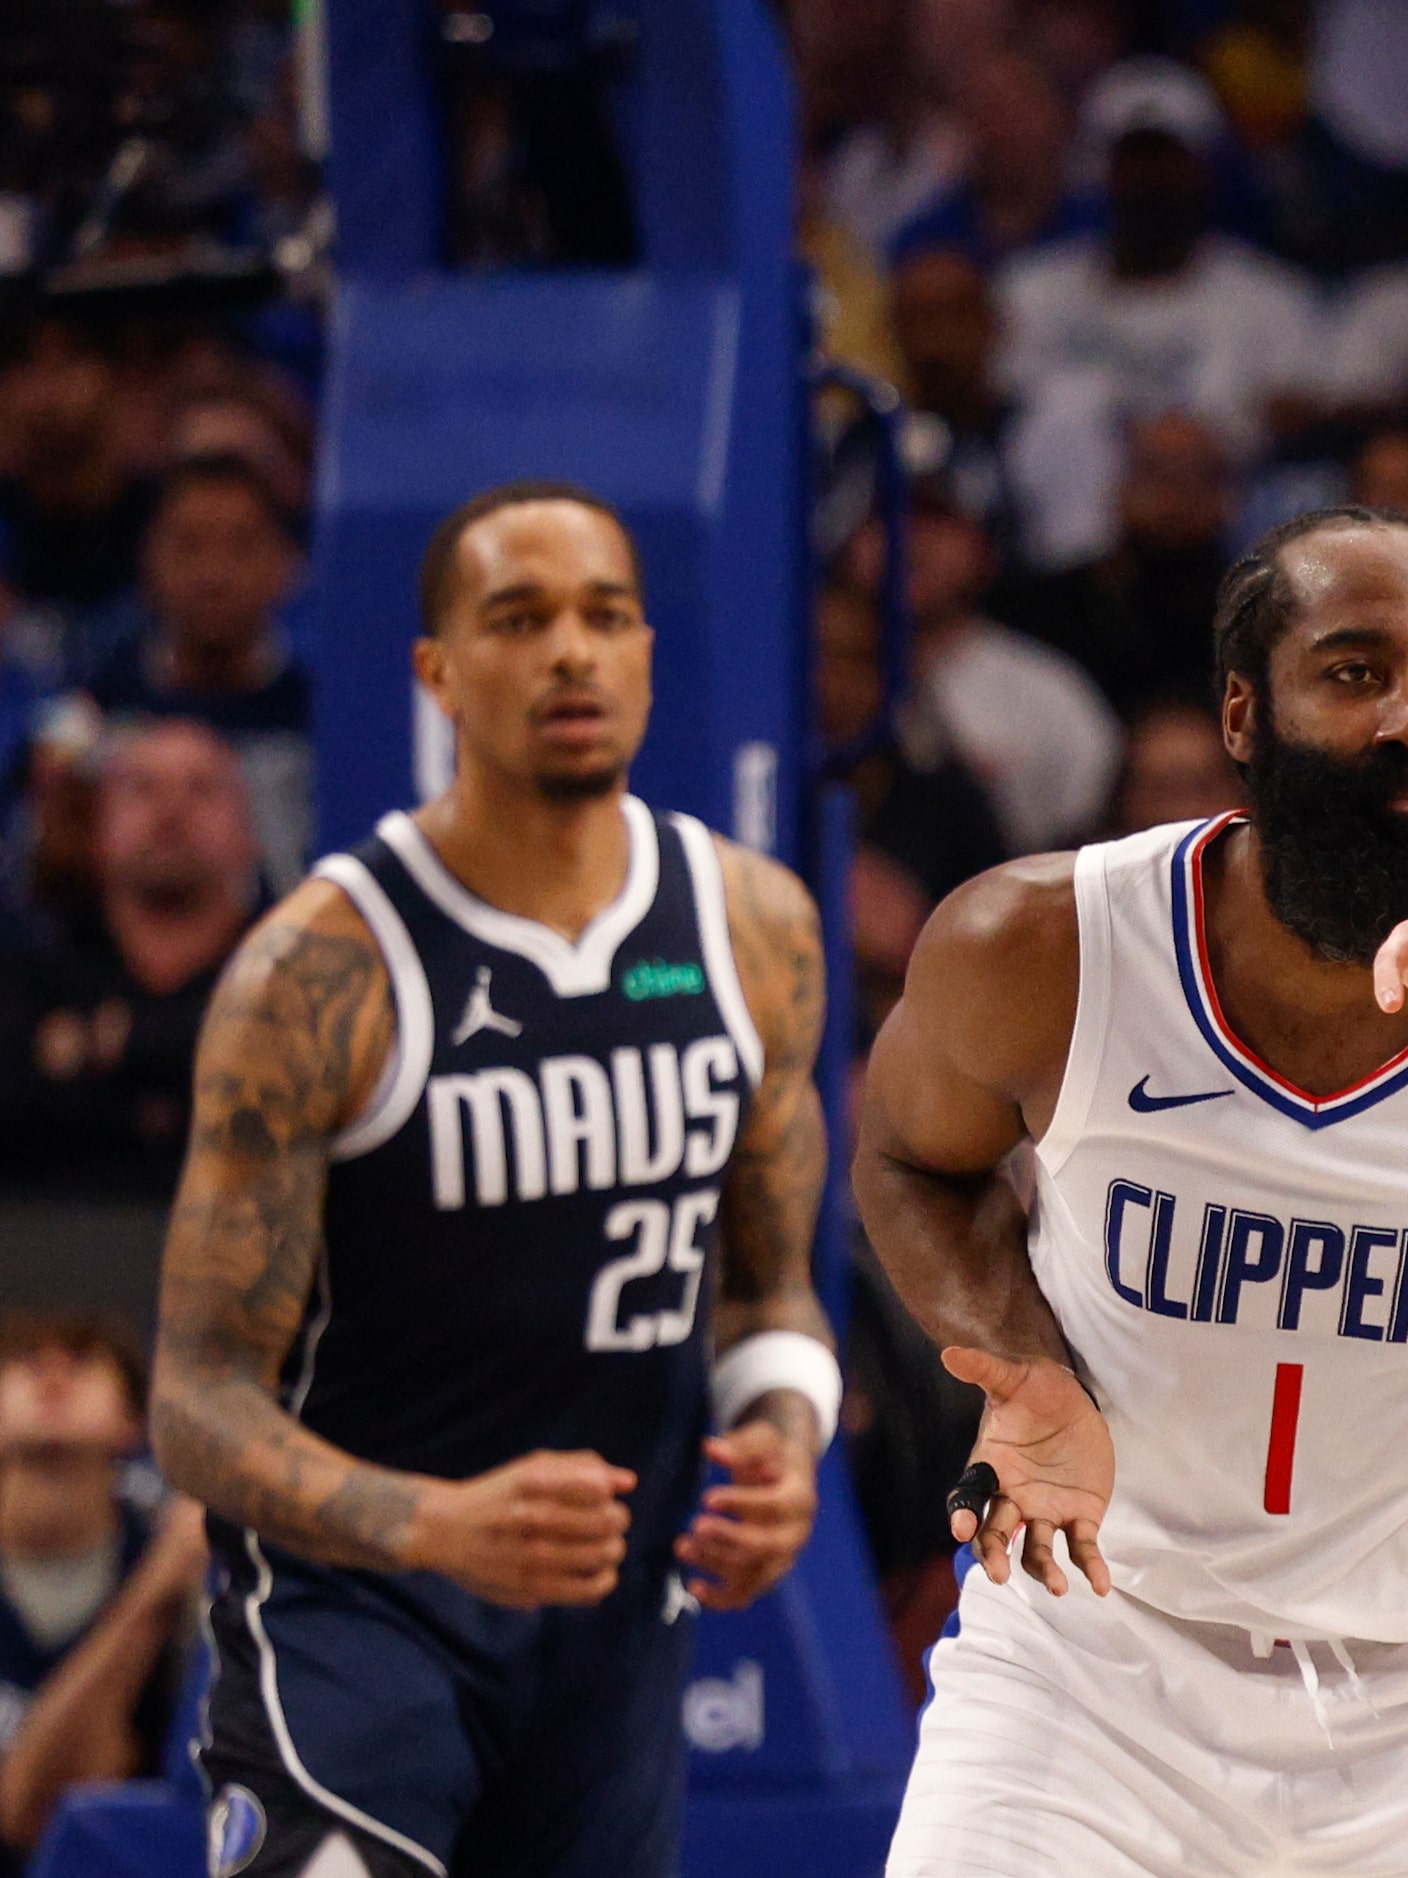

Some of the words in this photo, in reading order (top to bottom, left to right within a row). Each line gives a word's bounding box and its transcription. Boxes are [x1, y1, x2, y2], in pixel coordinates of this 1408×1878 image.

[428, 1034, 741, 1212] MAVS
[586, 1187, 722, 1353] 25
[1264, 1363, 1304, 1515] 1
